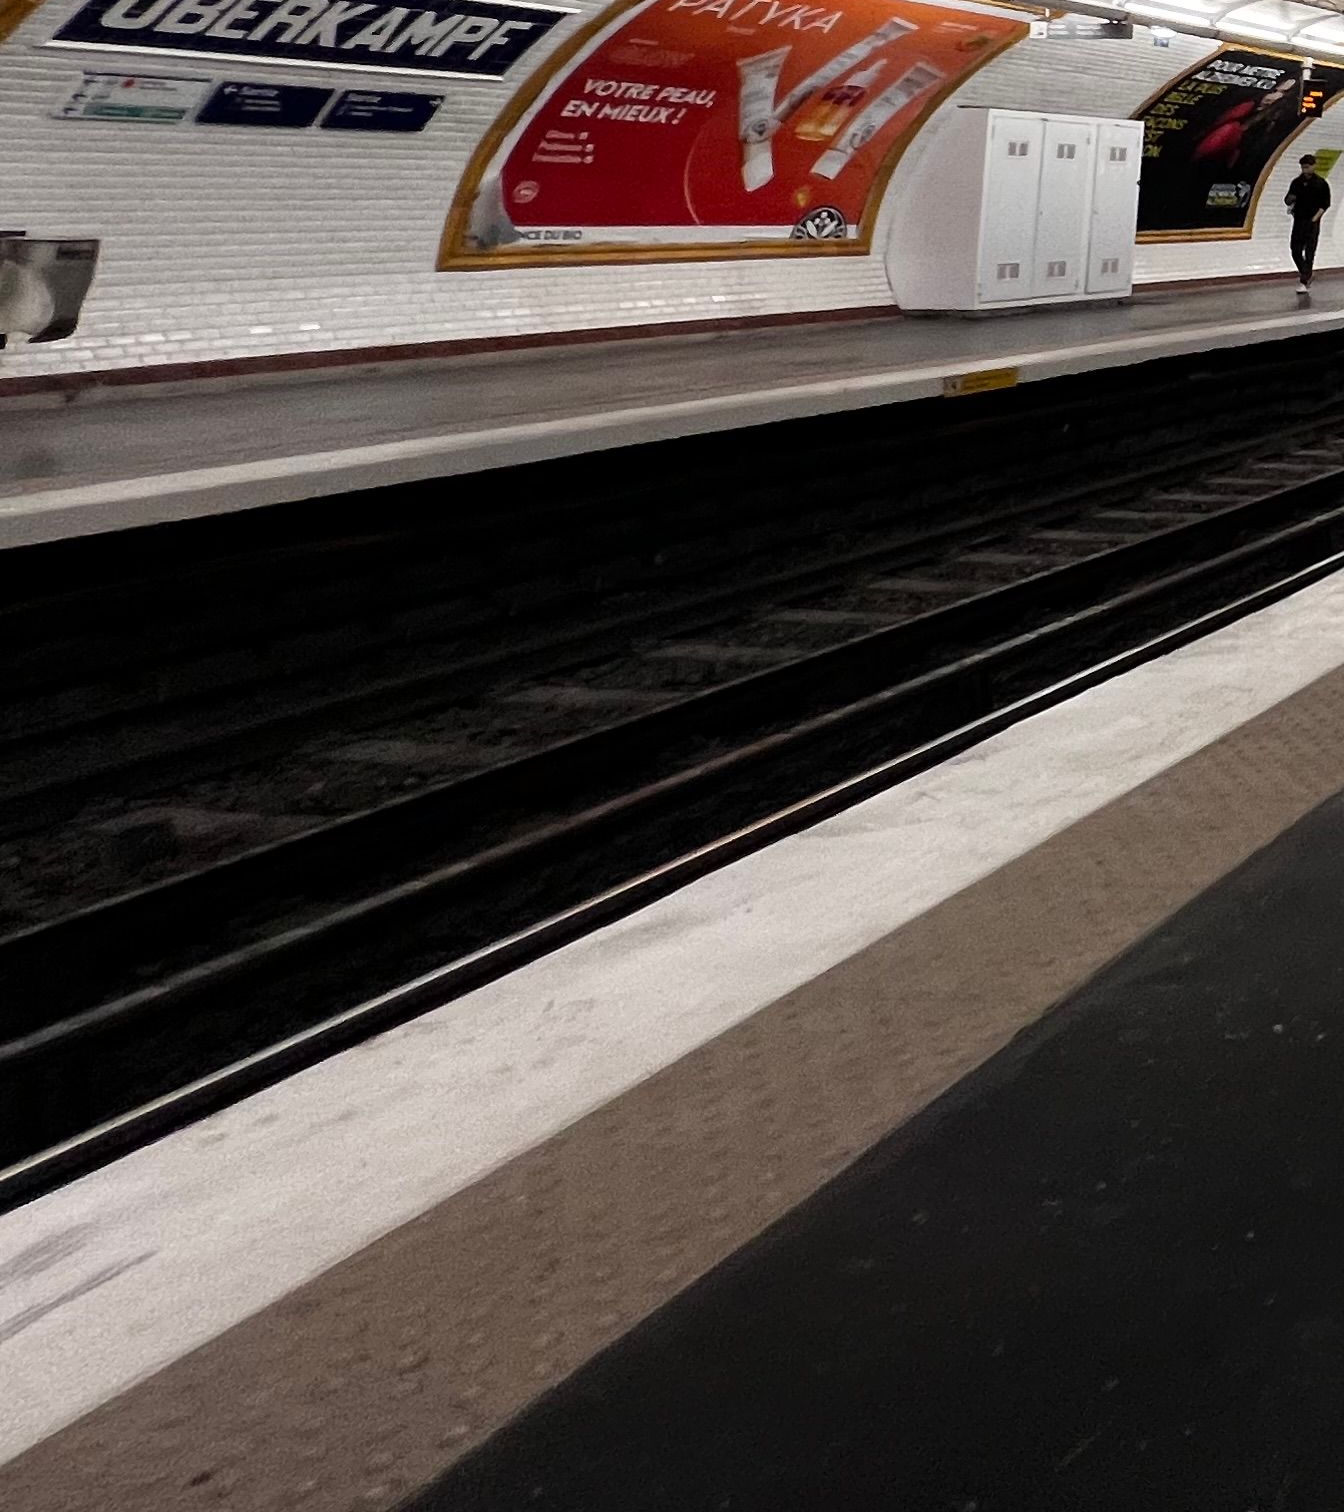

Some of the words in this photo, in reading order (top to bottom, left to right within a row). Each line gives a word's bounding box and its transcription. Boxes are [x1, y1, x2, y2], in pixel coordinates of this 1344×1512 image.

[584, 79, 660, 100] VOTRE
[655, 86, 717, 109] PEAU,
[560, 99, 600, 118] EN
